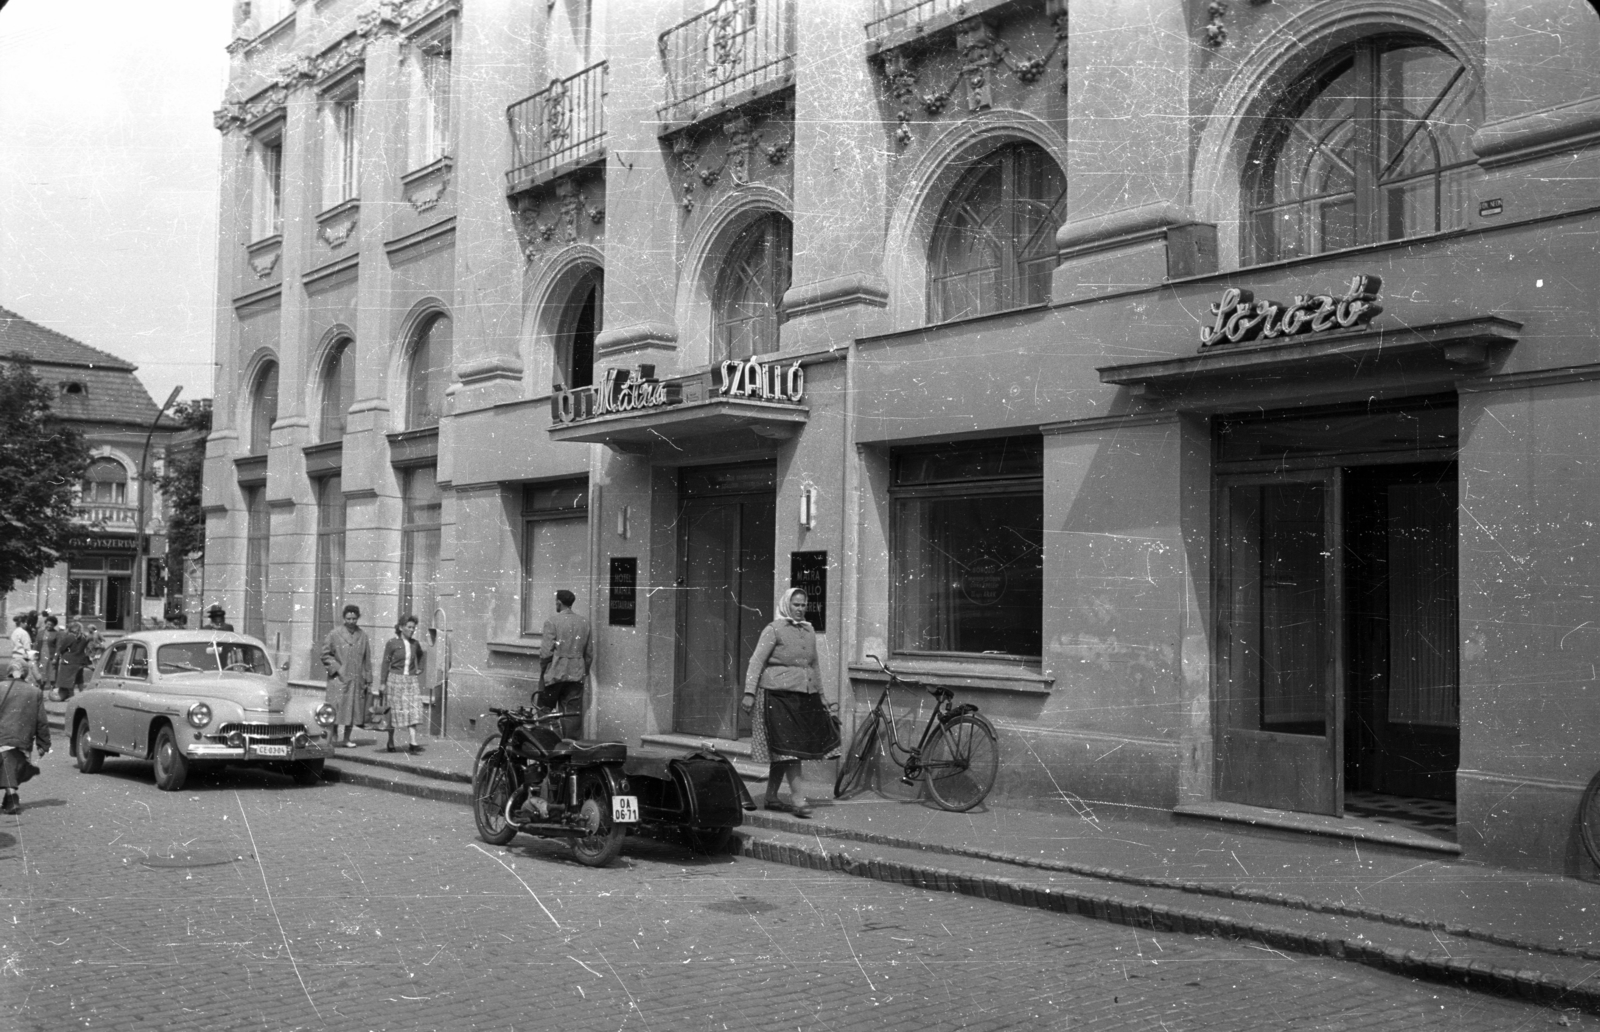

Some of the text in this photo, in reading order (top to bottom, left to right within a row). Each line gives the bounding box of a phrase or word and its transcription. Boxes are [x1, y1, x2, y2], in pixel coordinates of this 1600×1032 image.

[1200, 275, 1372, 345] Söröző
[718, 355, 804, 401] SZÁLLÓ
[592, 364, 668, 415] Mátra
[68, 537, 143, 549] GYGYSZERTÁ
[614, 573, 632, 583] HOTEL
[795, 582, 822, 596] ÁLLÓ
[610, 600, 635, 610] RESTAURANT
[619, 798, 631, 808] OA
